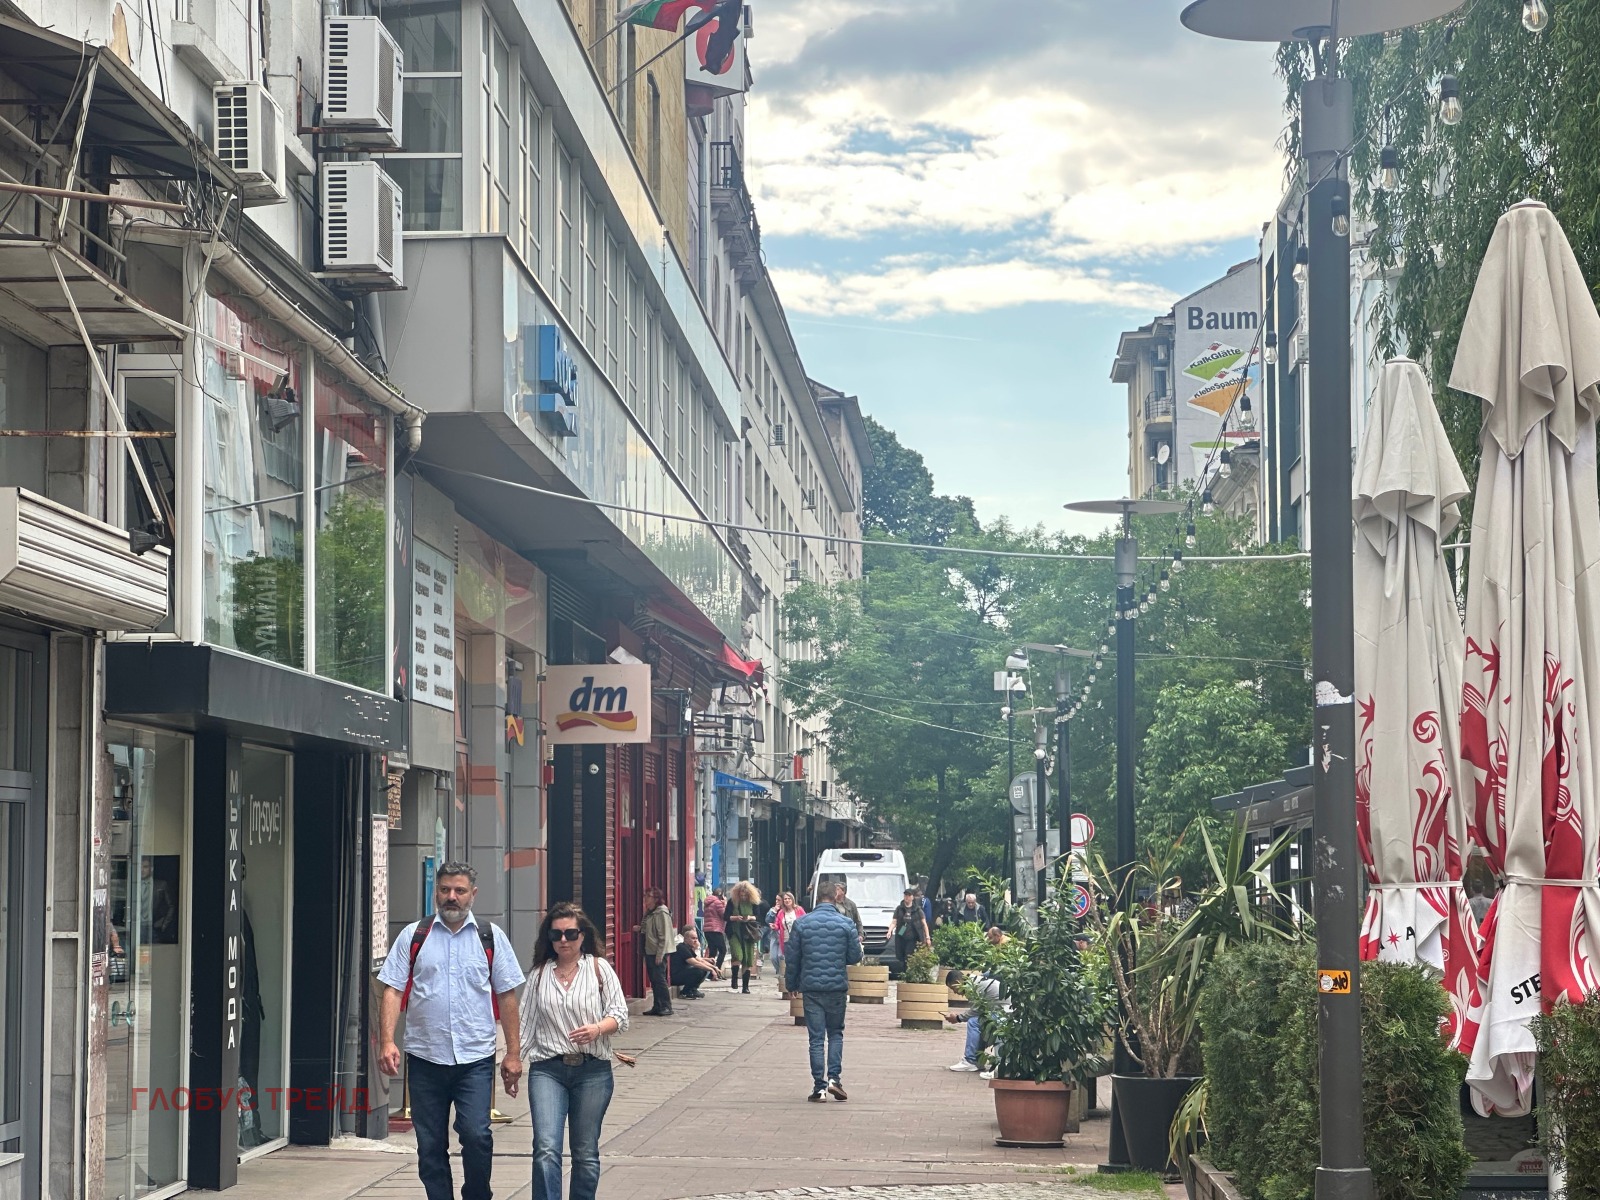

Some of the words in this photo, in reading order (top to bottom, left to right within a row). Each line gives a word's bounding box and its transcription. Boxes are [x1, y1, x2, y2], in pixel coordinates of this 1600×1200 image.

[1188, 306, 1258, 330] Baum
[569, 676, 628, 712] dm
[229, 769, 239, 912] МЪЖКА
[227, 936, 238, 1050] МОДА
[1510, 971, 1542, 1005] STE
